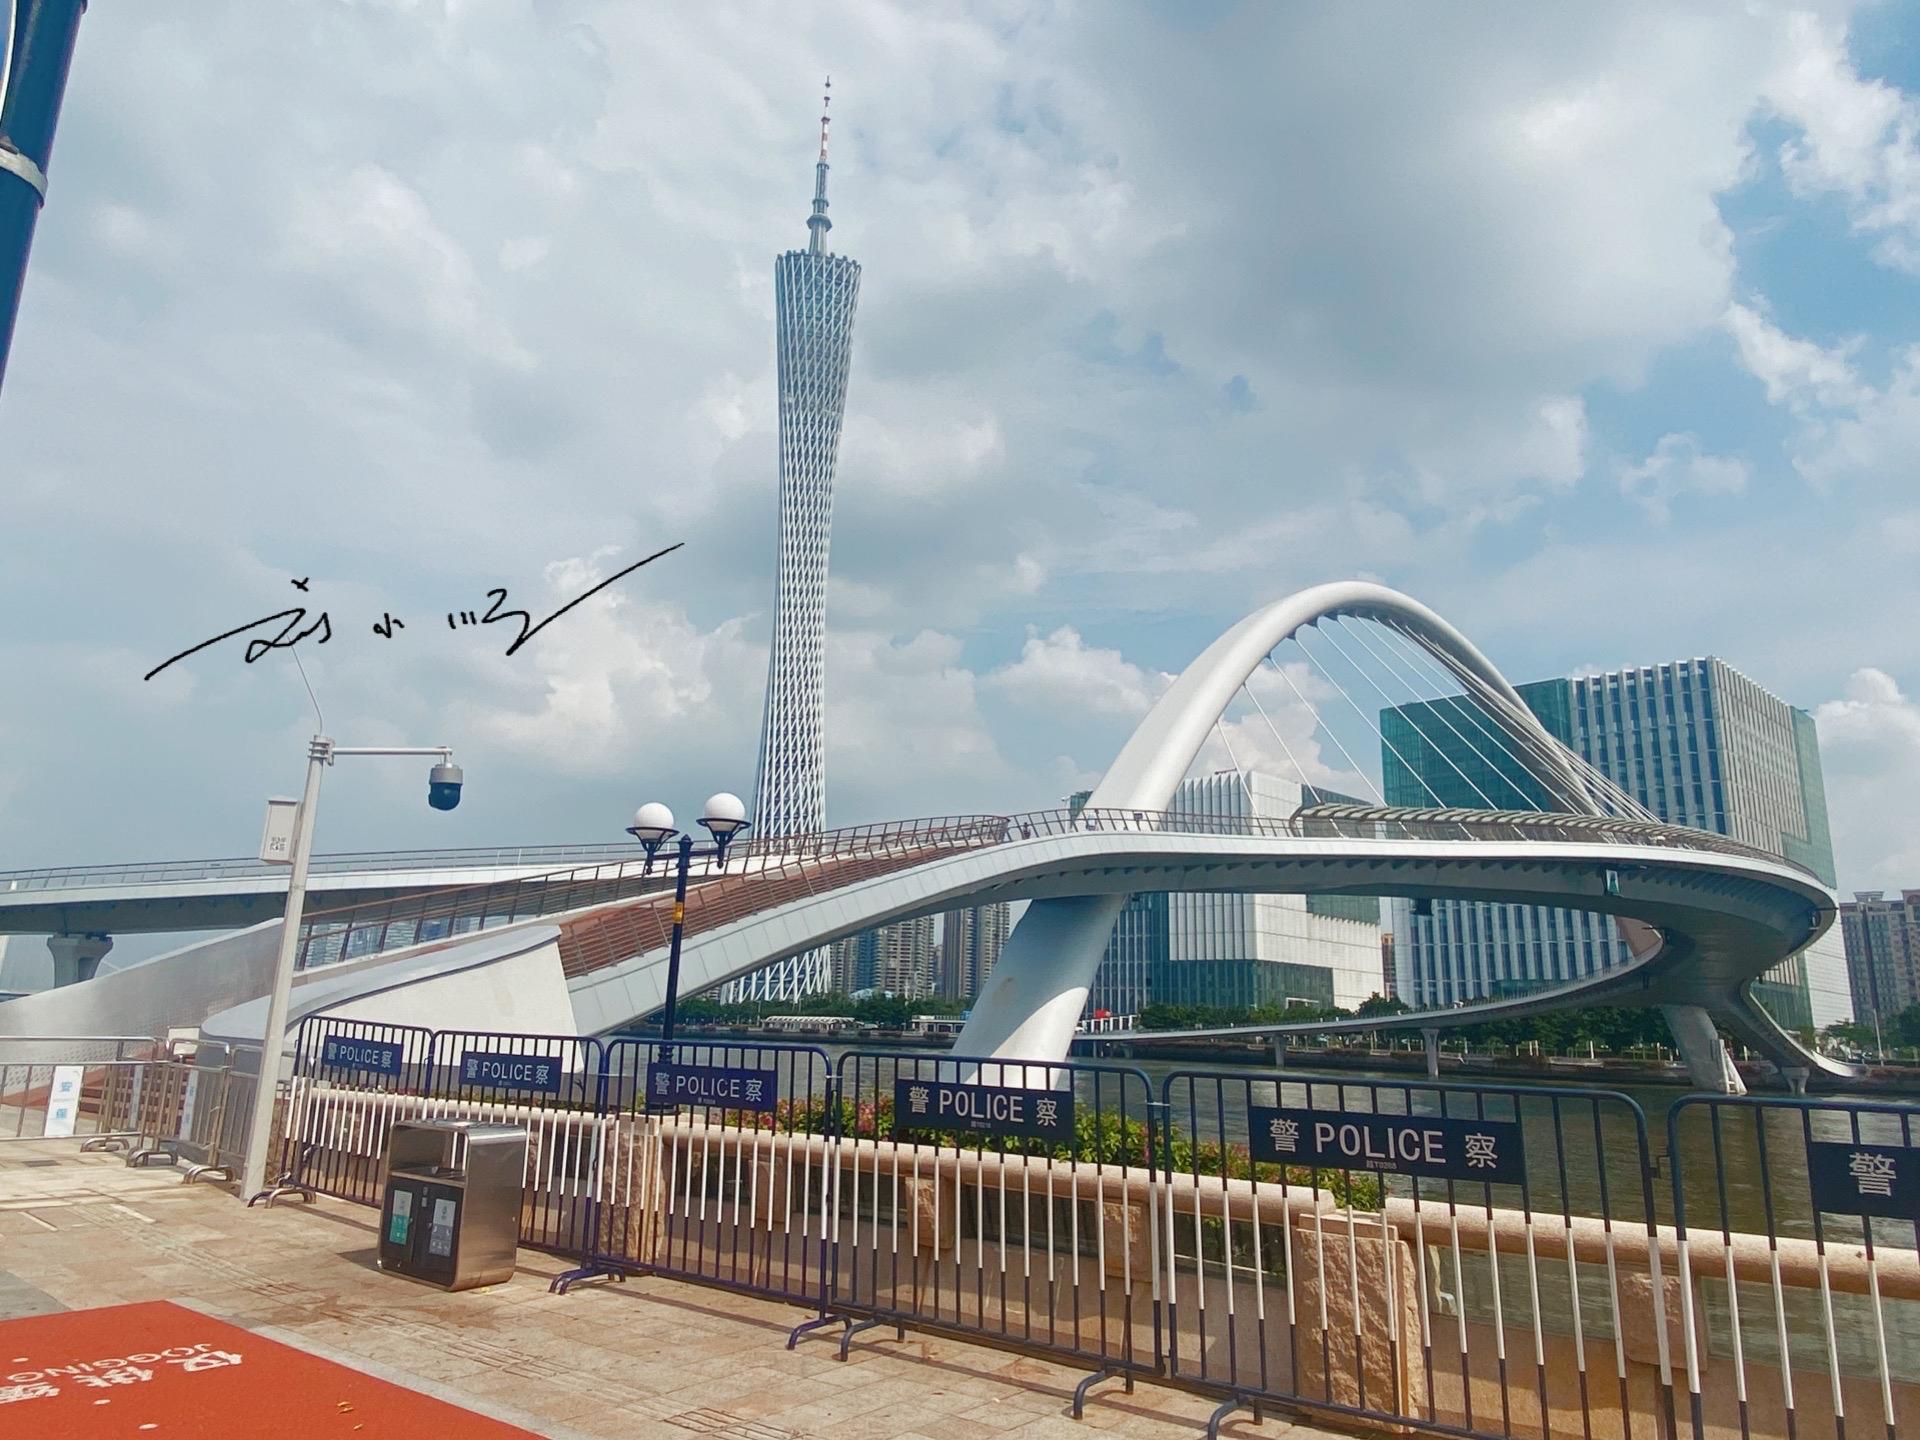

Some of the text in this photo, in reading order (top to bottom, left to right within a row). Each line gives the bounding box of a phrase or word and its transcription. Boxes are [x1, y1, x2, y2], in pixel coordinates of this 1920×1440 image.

[339, 1045, 380, 1065] POLICE
[381, 1050, 393, 1069] 察
[466, 1058, 550, 1085] 警 POLICE 察
[655, 1072, 763, 1102] 警 POLICE 察
[908, 1085, 1058, 1127] 警 POLICE 察
[1269, 1118, 1499, 1170] 警 POLICE 察
[1848, 1151, 1897, 1197] 警
[7, 1343, 212, 1383] JOGGING
